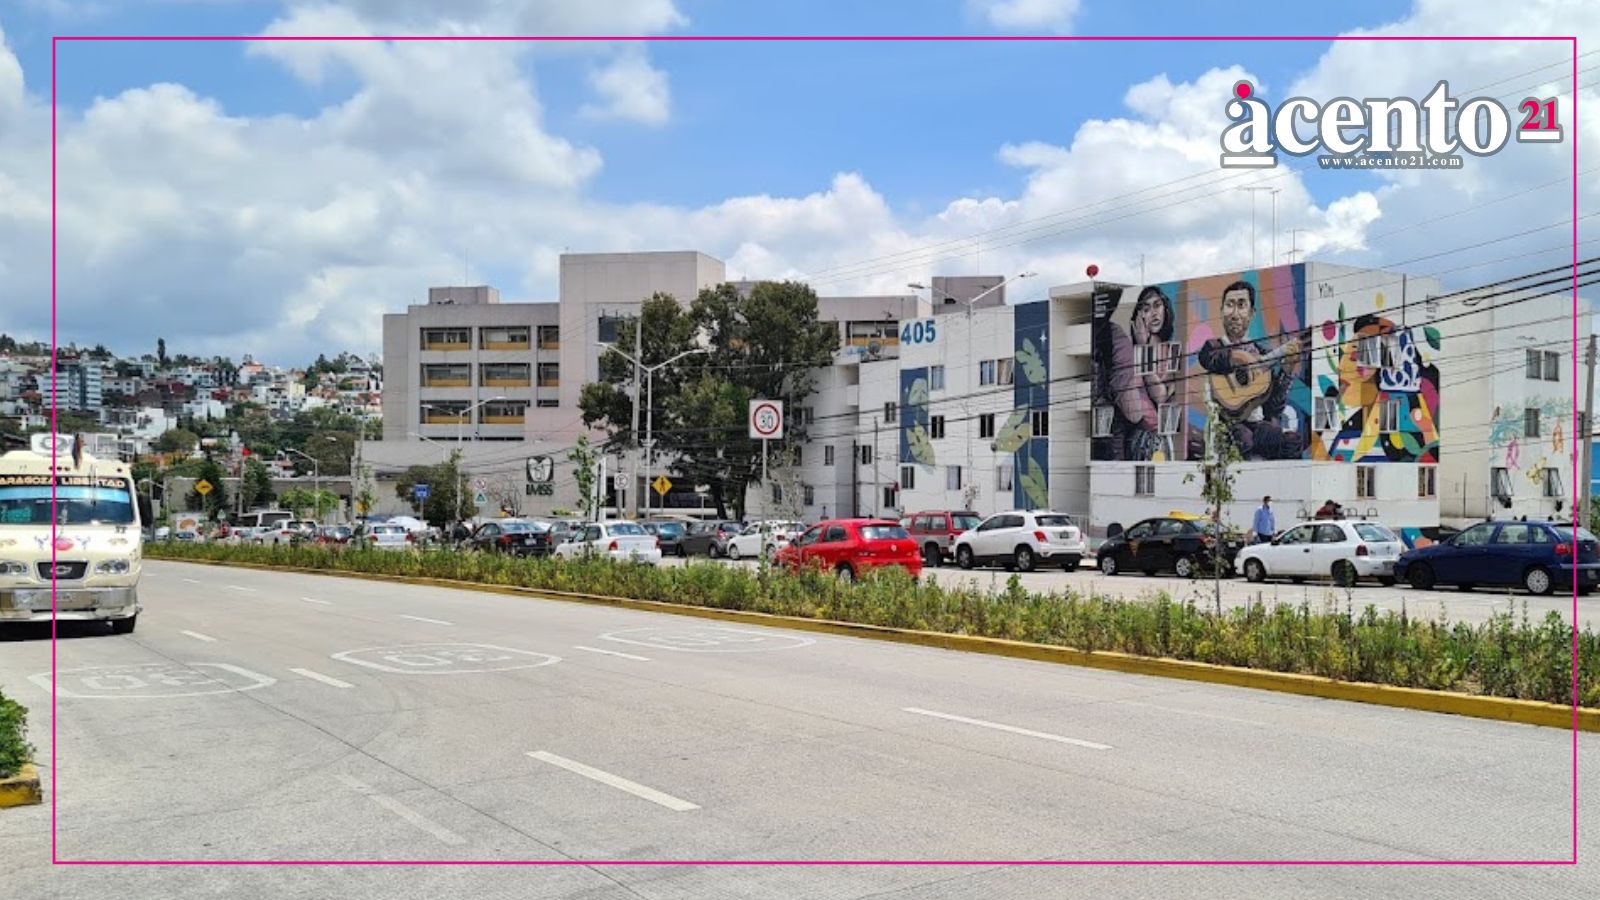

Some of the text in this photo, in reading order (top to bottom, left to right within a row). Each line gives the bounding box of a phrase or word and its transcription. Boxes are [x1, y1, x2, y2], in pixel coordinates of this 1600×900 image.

[900, 320, 936, 346] 405
[759, 414, 774, 429] 30
[526, 484, 554, 496] IMSS
